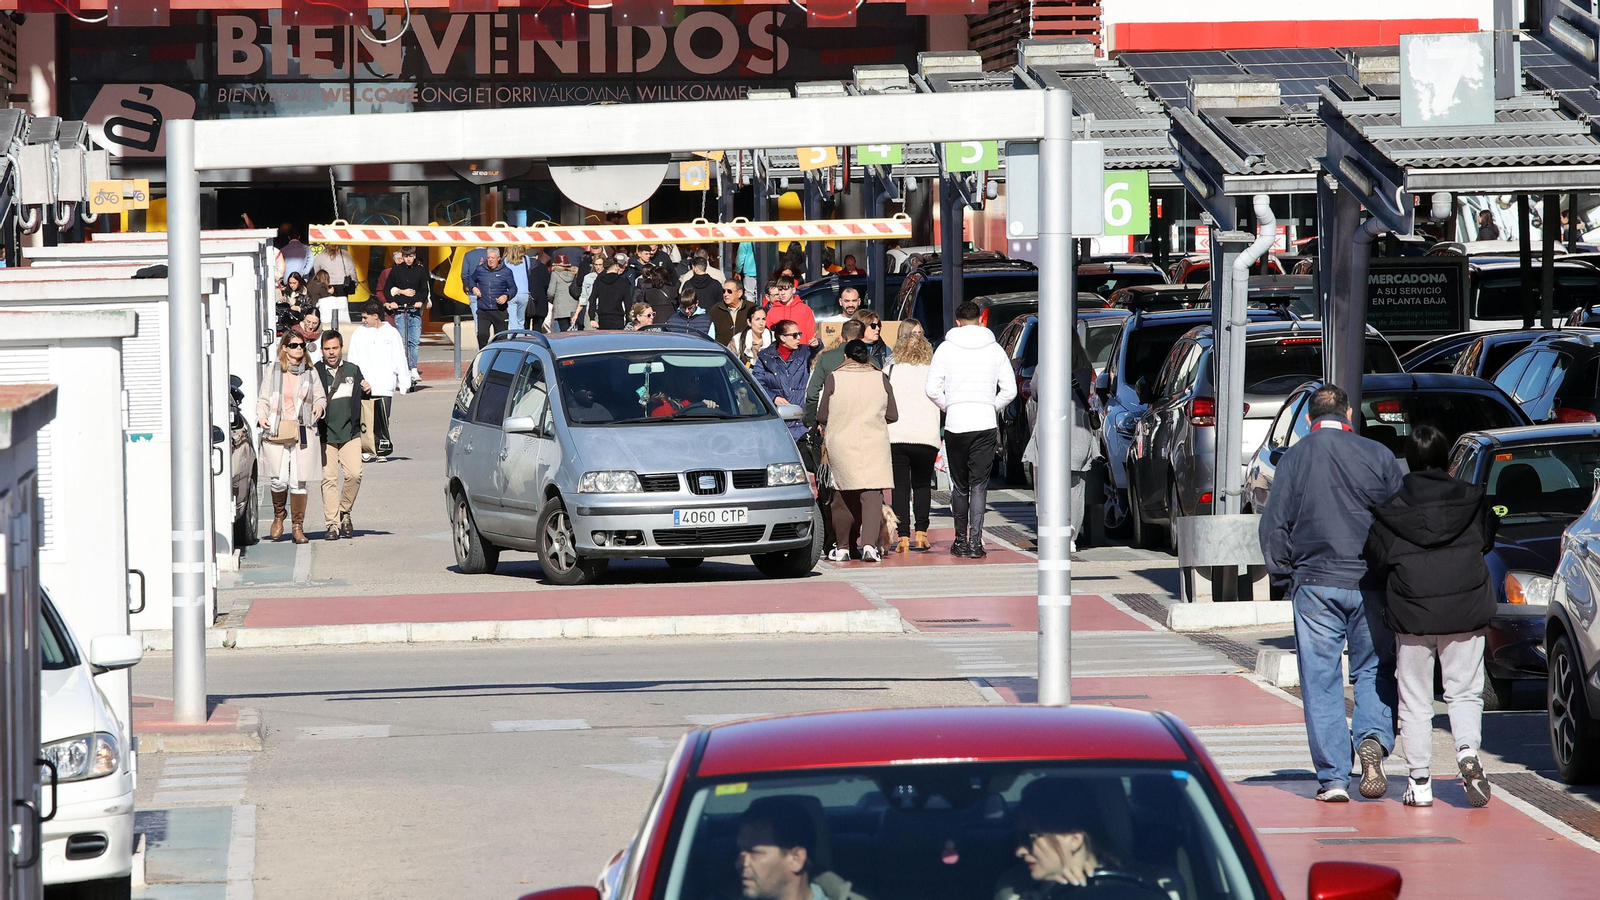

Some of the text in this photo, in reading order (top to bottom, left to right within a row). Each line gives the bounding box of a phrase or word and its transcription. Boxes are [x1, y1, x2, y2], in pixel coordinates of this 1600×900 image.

[216, 10, 789, 76] BIENVENIDOS
[320, 87, 419, 103] WELCOME
[538, 83, 631, 101] VÄLKOMNA
[1104, 182, 1132, 226] 6
[1368, 273, 1448, 285] MERCADONA
[1385, 287, 1397, 295] SU
[1400, 286, 1442, 295] SERVICIO
[1372, 298, 1385, 306] EN
[1423, 297, 1447, 305] BAJA
[682, 509, 745, 523] 4060 CTP
